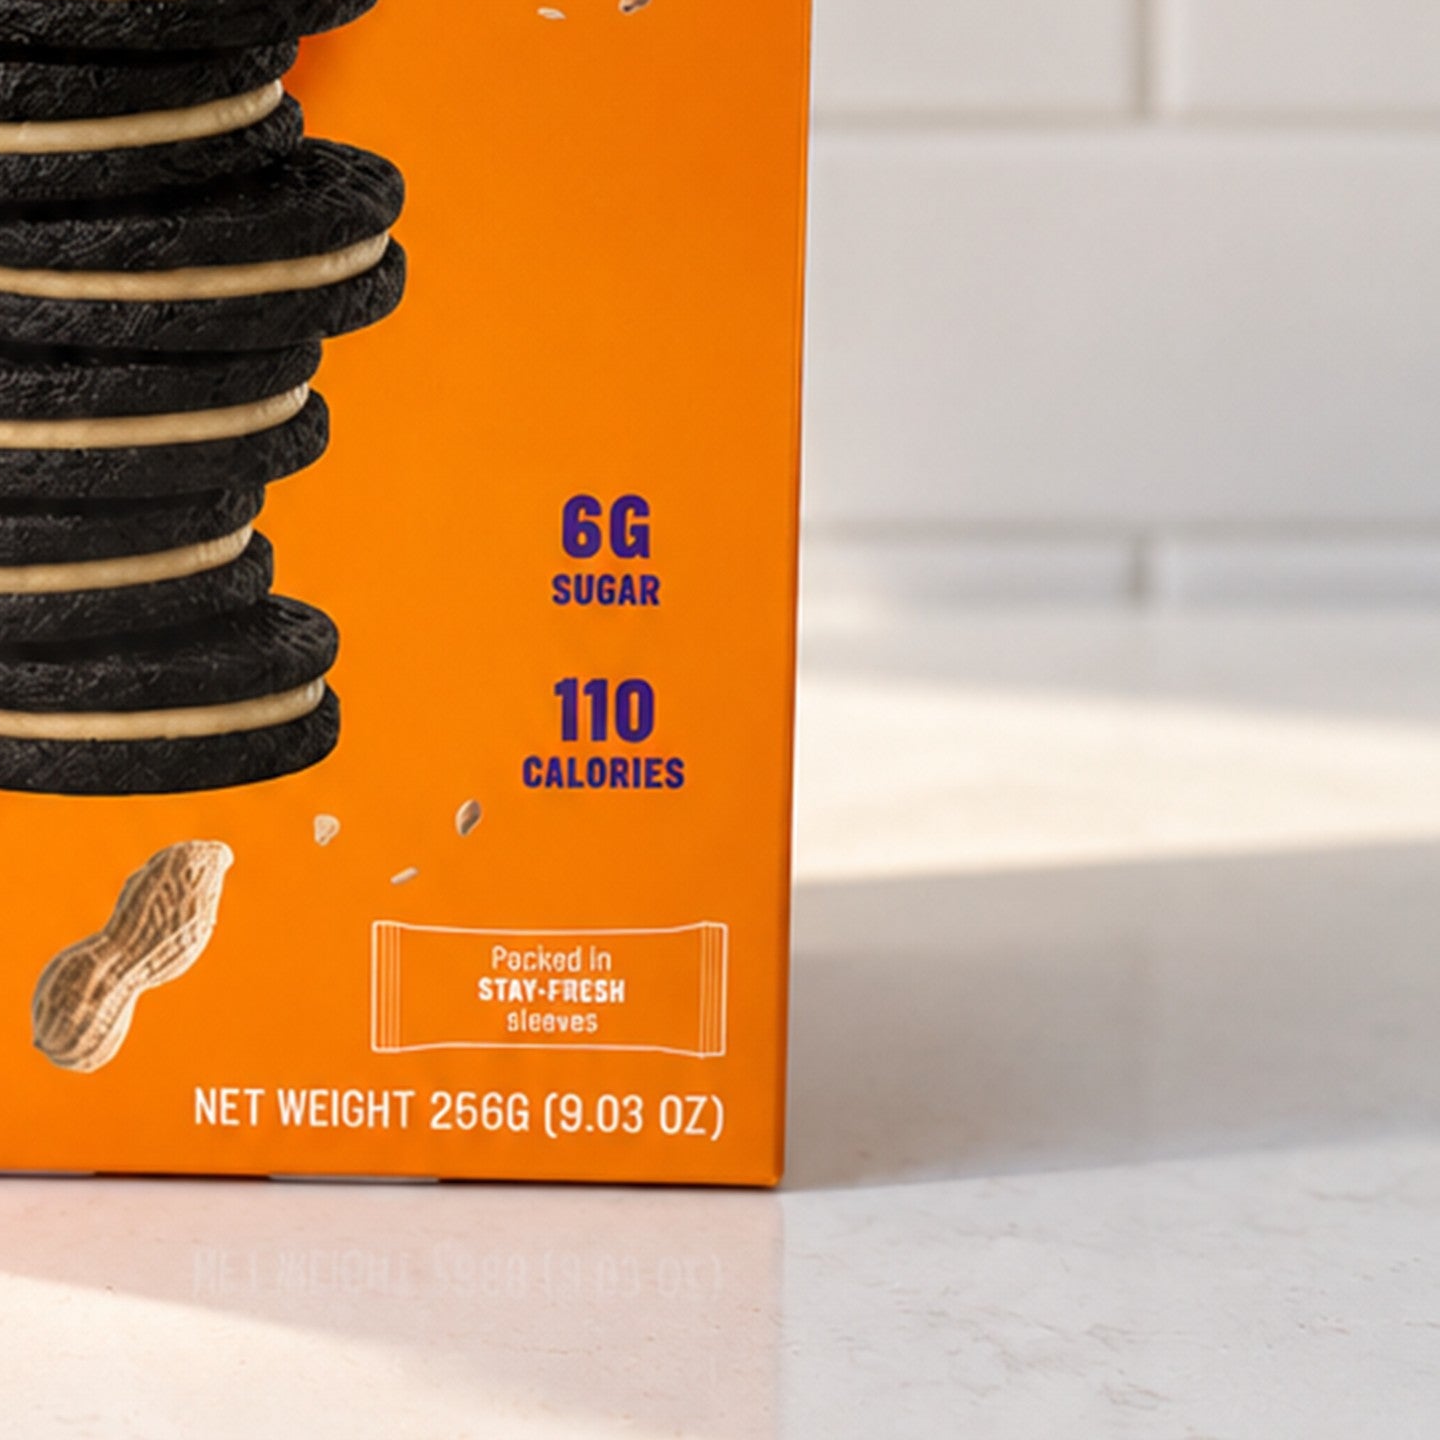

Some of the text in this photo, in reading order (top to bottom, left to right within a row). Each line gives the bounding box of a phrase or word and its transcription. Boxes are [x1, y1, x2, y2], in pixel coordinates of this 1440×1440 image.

[562, 494, 650, 559] 6G
[551, 573, 661, 606] SUGAR
[554, 677, 655, 744] 110
[522, 755, 685, 790] CALORIES
[478, 976, 626, 1003] STAY-FRESH
[507, 1008, 598, 1033] sleeves
[194, 1086, 725, 1141] NET WEIGHT 256G (9.03 OZ)
